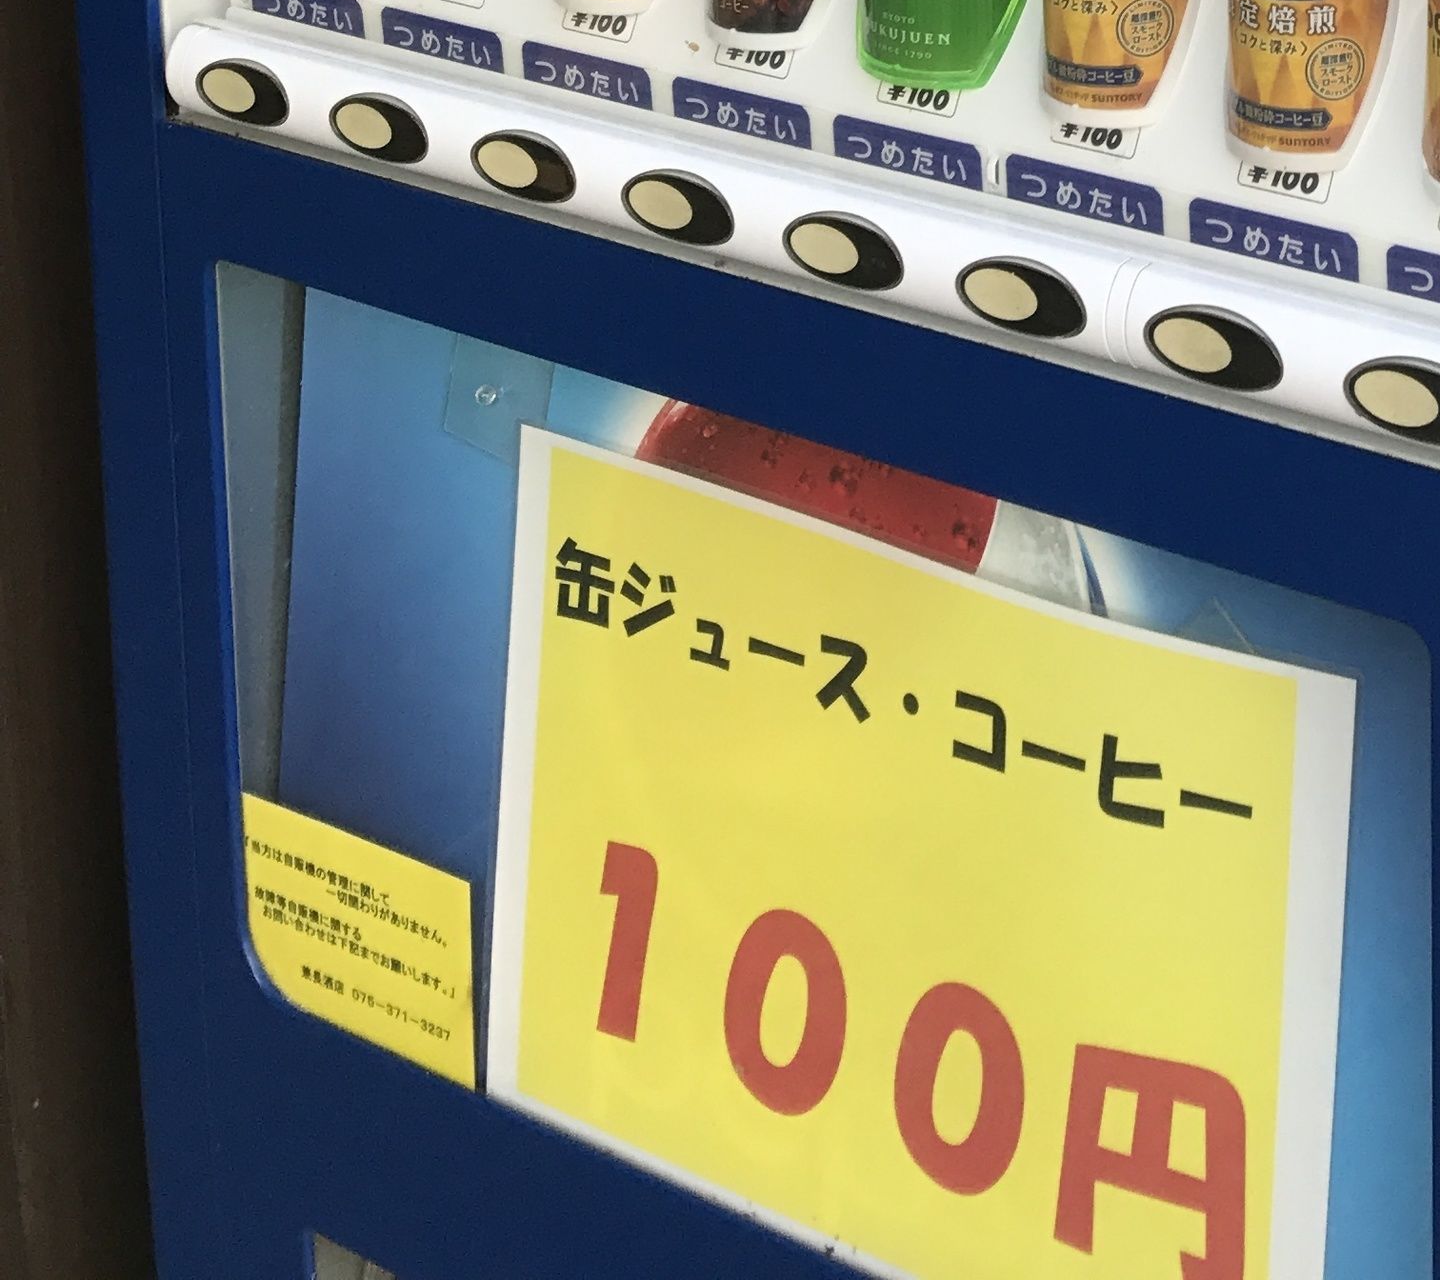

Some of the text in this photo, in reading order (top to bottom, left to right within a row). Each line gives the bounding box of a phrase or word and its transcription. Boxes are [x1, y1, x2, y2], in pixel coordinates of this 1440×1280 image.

[848, 135, 967, 181] つめたい
[554, 537, 1253, 828] 缶ジュース・コーヒー
[596, 840, 1248, 1280] 100円
